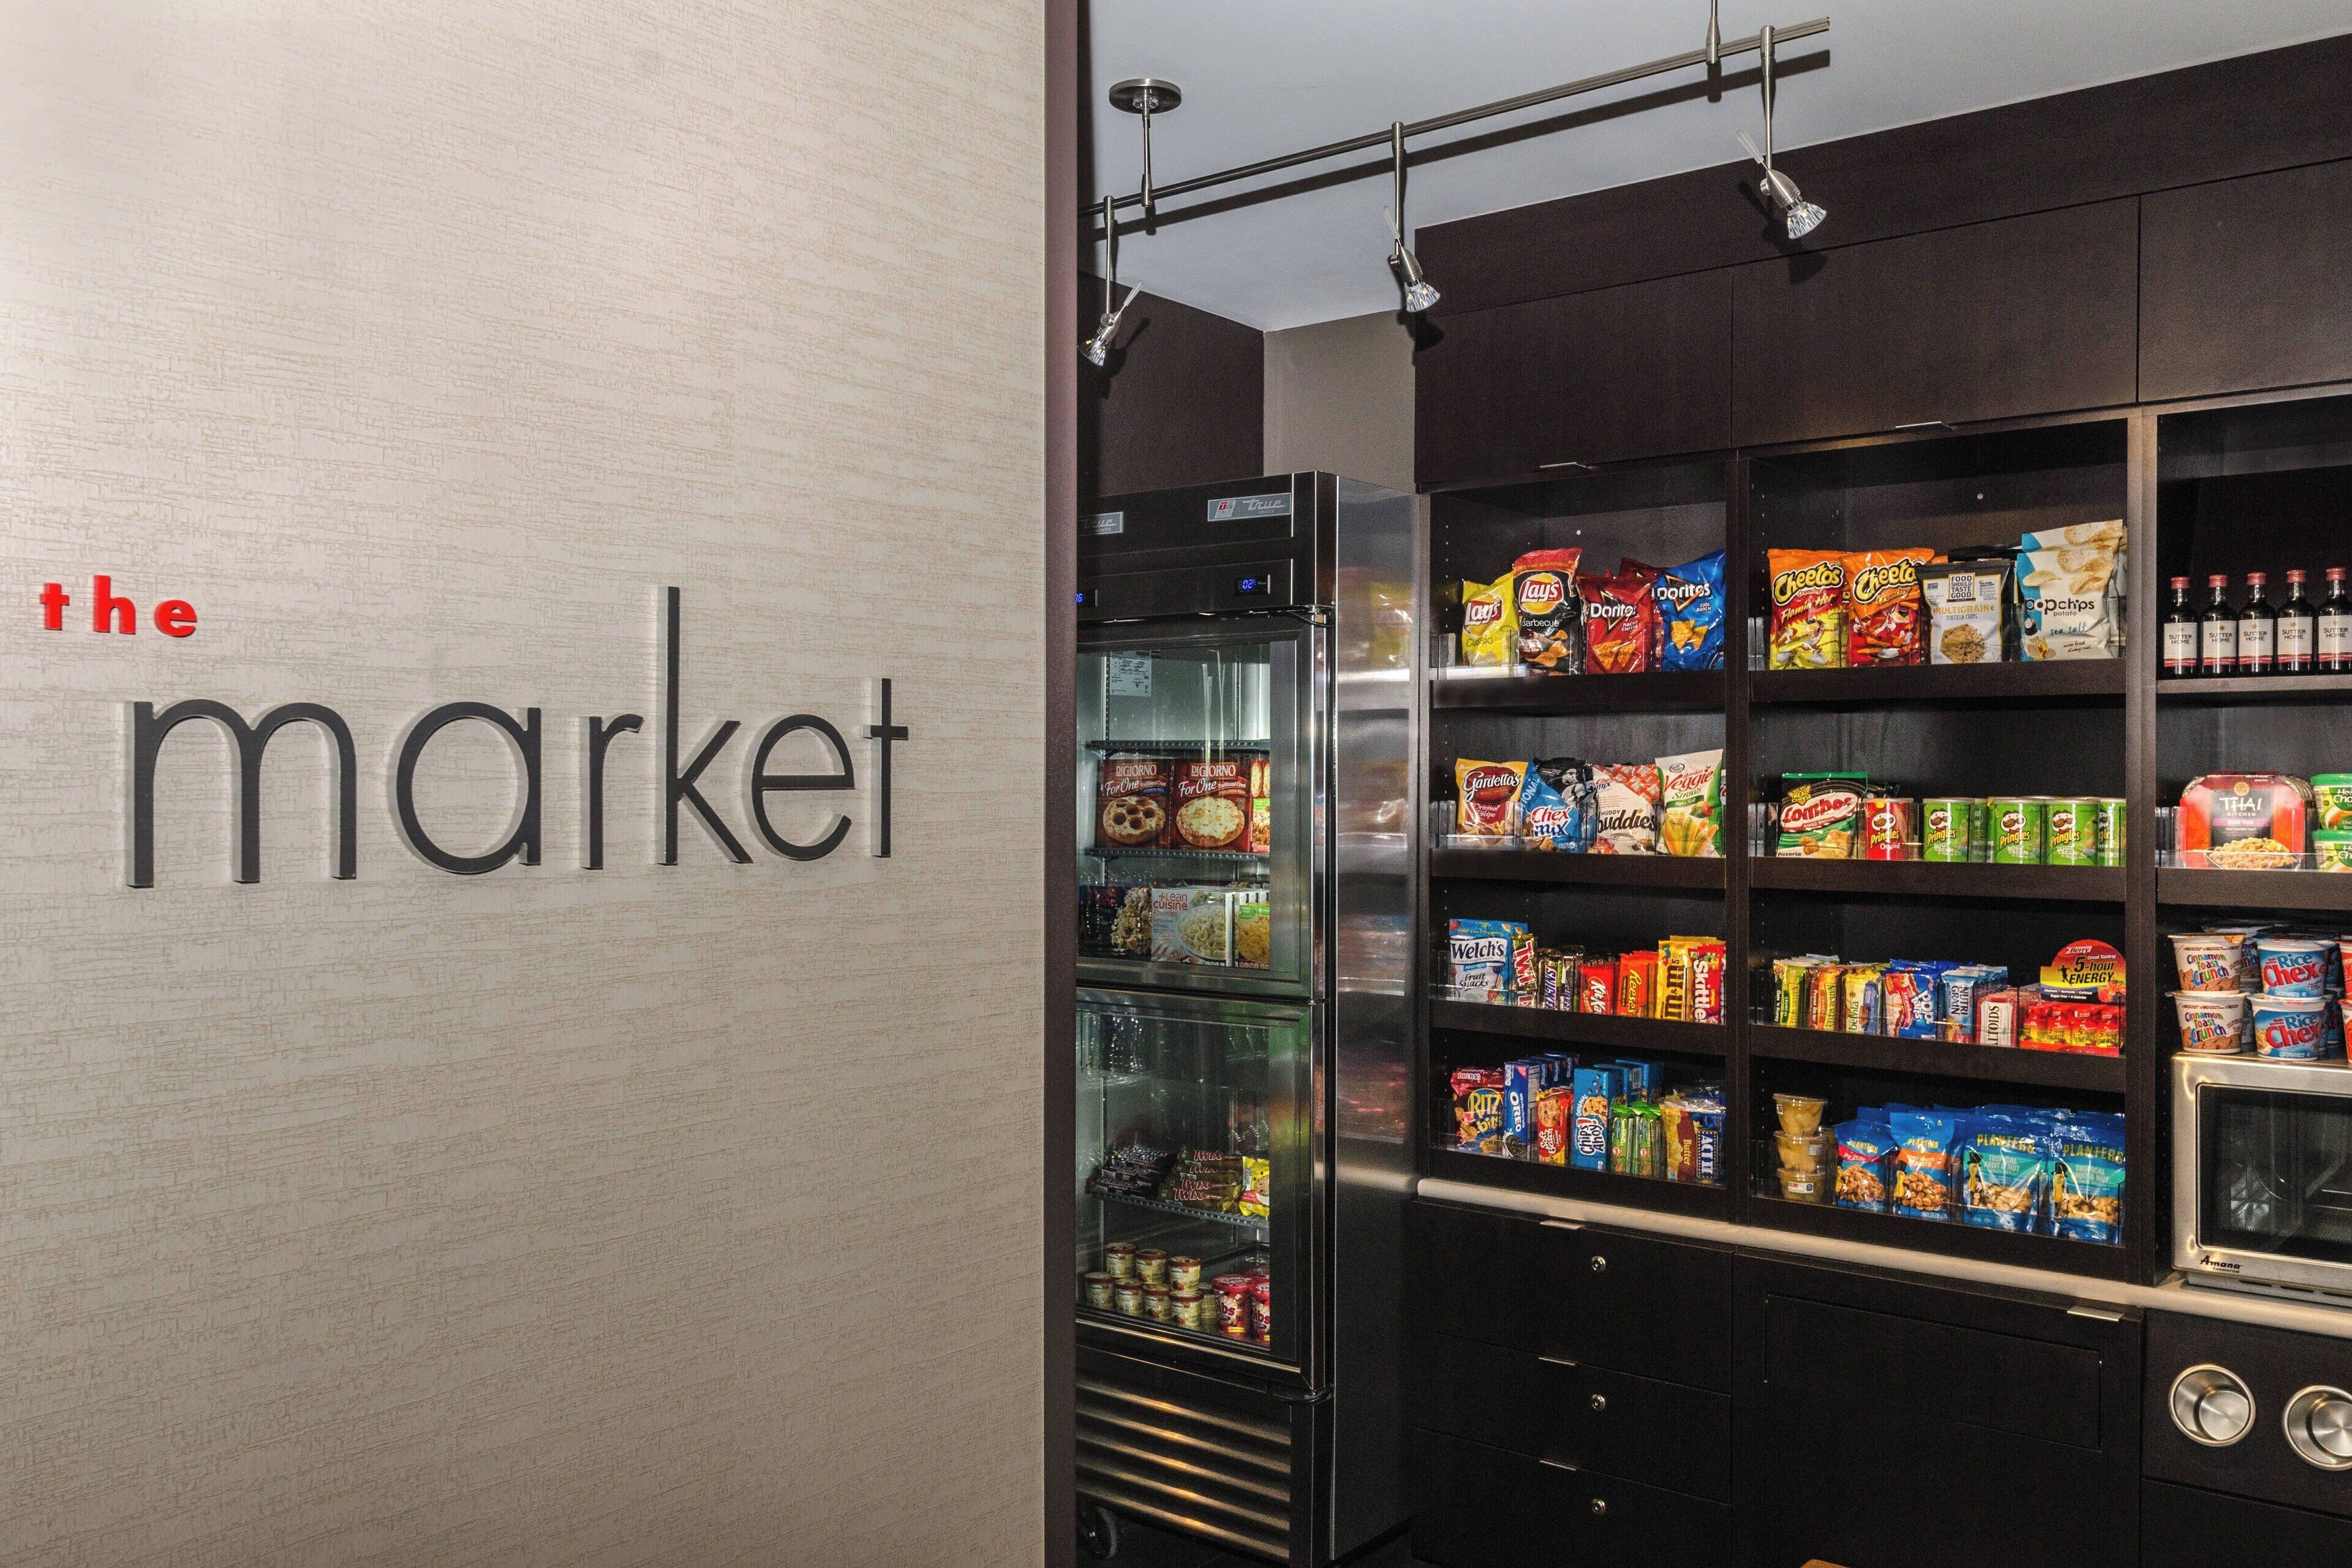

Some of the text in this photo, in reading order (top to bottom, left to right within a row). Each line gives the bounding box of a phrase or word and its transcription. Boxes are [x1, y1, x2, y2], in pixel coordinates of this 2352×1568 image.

[1521, 581, 1559, 603] Lay's
[1657, 583, 1711, 600] Doritos
[1773, 562, 1841, 605] Cheetos
[1797, 587, 1822, 597] Crunchy
[1815, 594, 1836, 606] Hot
[1876, 587, 1911, 605] Crunchy
[40, 575, 197, 638] the
[1465, 601, 1501, 626] Lay's
[1936, 605, 1989, 614] MULTIGRAIN
[2025, 598, 2095, 614] popchips
[2068, 621, 2087, 634] salt
[1466, 636, 1493, 647] Classic
[126, 586, 909, 889] market
[1105, 777, 1140, 796] For One
[1178, 777, 1216, 797] For One
[1463, 771, 1520, 802] Gardetto's
[1664, 767, 1714, 793] Veggie
[1792, 794, 1812, 803] CHEESE
[2219, 797, 2262, 812] THAI
[1473, 804, 1500, 812] Original
[1532, 806, 1572, 823] Chex
[1782, 797, 1852, 823] Combos
[1534, 821, 1569, 837] mix
[1598, 809, 1656, 834] buddies
[1871, 830, 1899, 848] Pringles
[1928, 829, 1956, 846] Pringles
[1999, 830, 2030, 850] Pringles
[2051, 829, 2080, 848] Pringles
[1450, 941, 1504, 959] Welch's
[2187, 953, 2226, 964] Cinnamon
[2074, 956, 2117, 972] 5-hour
[2196, 961, 2220, 972] Toast
[2277, 953, 2313, 968] Rice
[2069, 972, 2115, 984] ENERGY
[2192, 966, 2230, 988] Crunch
[2264, 962, 2320, 987] Chex
[1627, 970, 1642, 1015] Reese's
[1694, 960, 1710, 1022] Skittle
[1902, 992, 1912, 1024] Strawberry
[1951, 986, 1960, 1015] GRAIN
[1960, 987, 1969, 1015] NUTRI
[1849, 1001, 1859, 1032] belVita
[2185, 1012, 2224, 1022] Cinnamon
[2193, 1019, 2215, 1030] Toast
[2285, 1014, 2316, 1030] Rice
[2190, 1024, 2227, 1045] Crunch
[2266, 1023, 2321, 1048] Chex
[1471, 1093, 1502, 1118] RITZ
[1509, 1091, 1522, 1132] OREO
[1577, 1094, 1589, 1116] ORIGINAL
[1477, 1116, 1502, 1133] bits
[1684, 1139, 1692, 1166] Butter
[1848, 1140, 1878, 1153] PLANTERS
[1908, 1139, 1939, 1148] PLANTERS
[1977, 1134, 2035, 1155] PLANTERS
[2063, 1144, 2124, 1164] PLANTERS
[2076, 1165, 2105, 1175] TROPICAL
[2200, 1255, 2241, 1268] Amana
